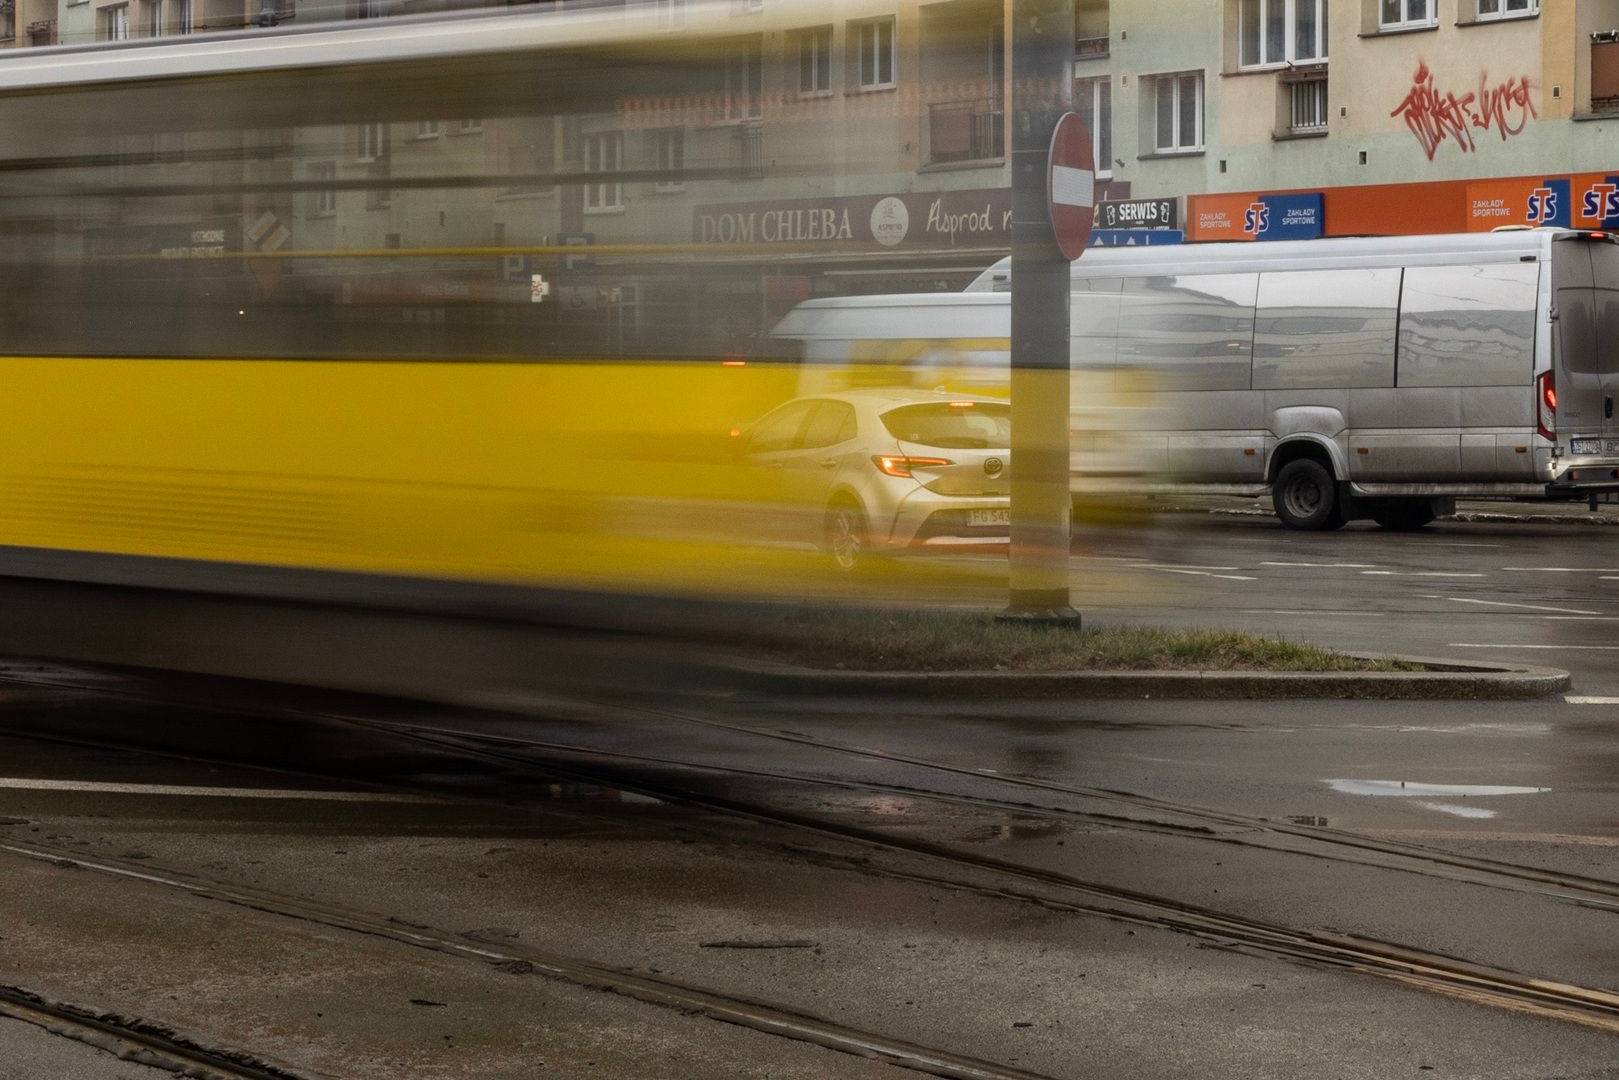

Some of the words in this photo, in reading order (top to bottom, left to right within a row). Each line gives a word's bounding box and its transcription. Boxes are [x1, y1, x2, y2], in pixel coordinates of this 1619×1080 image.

[1472, 199, 1505, 208] ZAKŁADY
[1526, 187, 1557, 223] STS
[1119, 202, 1157, 221] SERWIS
[1199, 212, 1226, 221] ZAKŁADY
[1287, 208, 1316, 217] ZAKŁADY
[1472, 208, 1511, 217] SPORTOWE
[926, 198, 993, 245] Asprod
[1243, 202, 1270, 235] STS
[1282, 216, 1316, 226] SPORTOWE
[701, 214, 755, 244] DOM
[761, 208, 853, 242] CHLEBA
[1199, 220, 1232, 229] SPORTOWE
